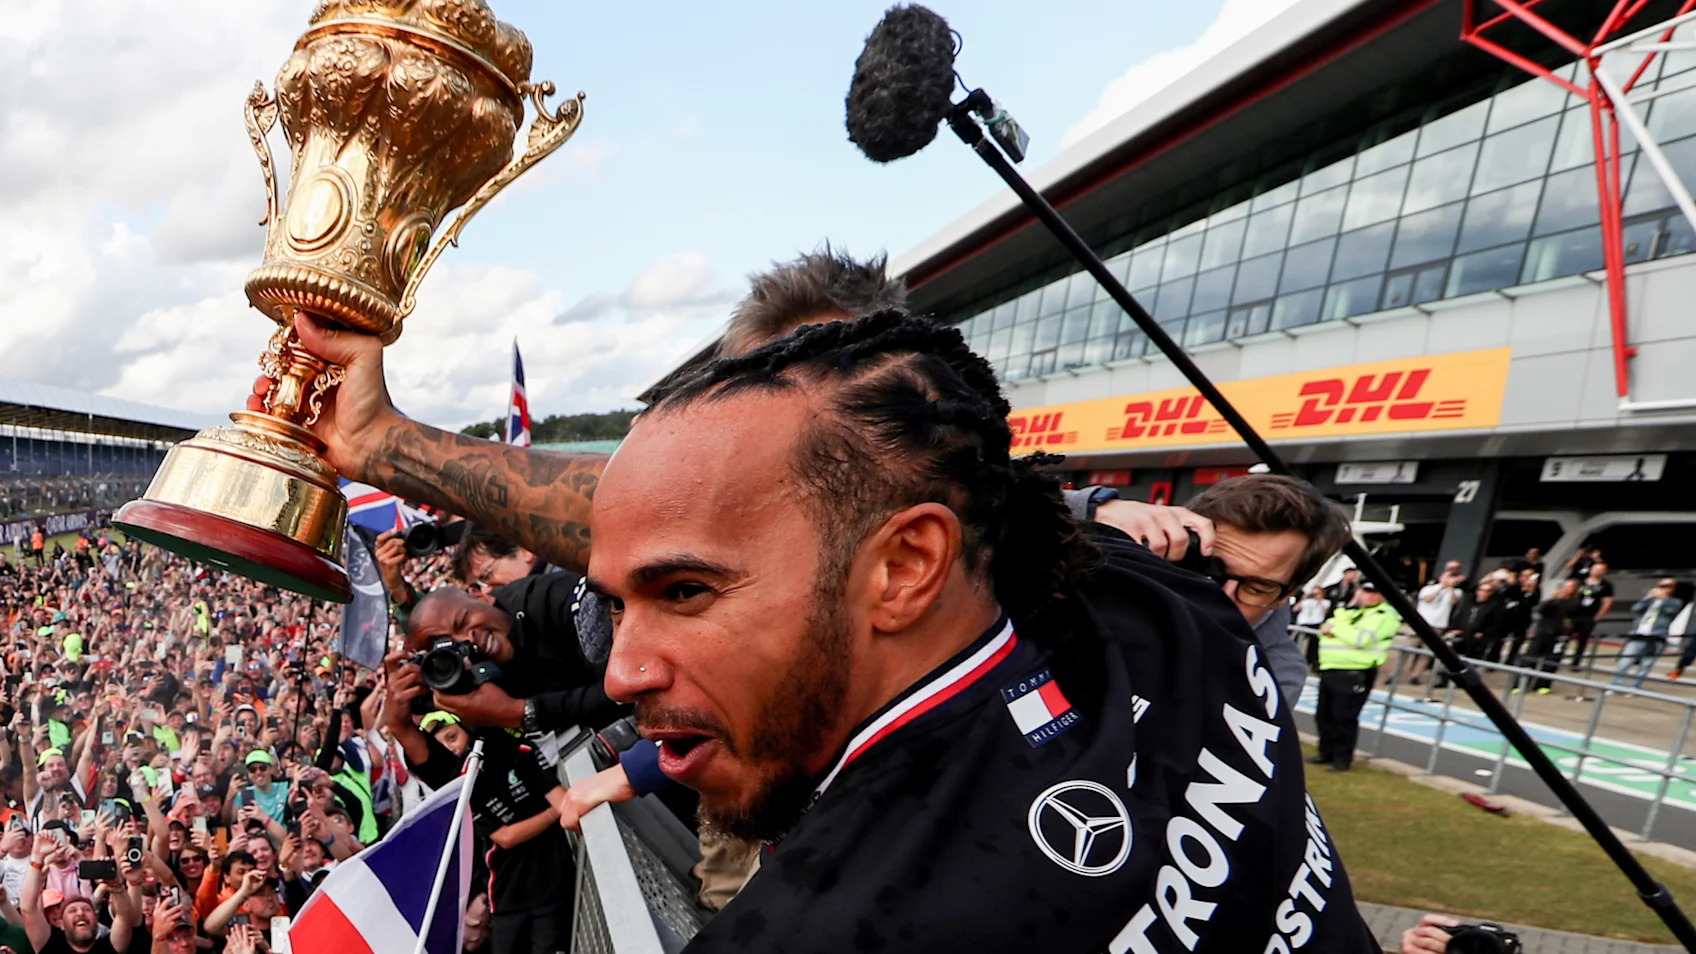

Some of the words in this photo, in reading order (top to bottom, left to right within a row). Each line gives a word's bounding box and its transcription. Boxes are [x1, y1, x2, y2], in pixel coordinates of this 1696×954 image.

[1293, 368, 1433, 427] DHL
[1010, 412, 1064, 447] DHL
[1121, 394, 1208, 439] DHL
[1455, 480, 1481, 503] 27
[1031, 711, 1079, 743] HILFIGER
